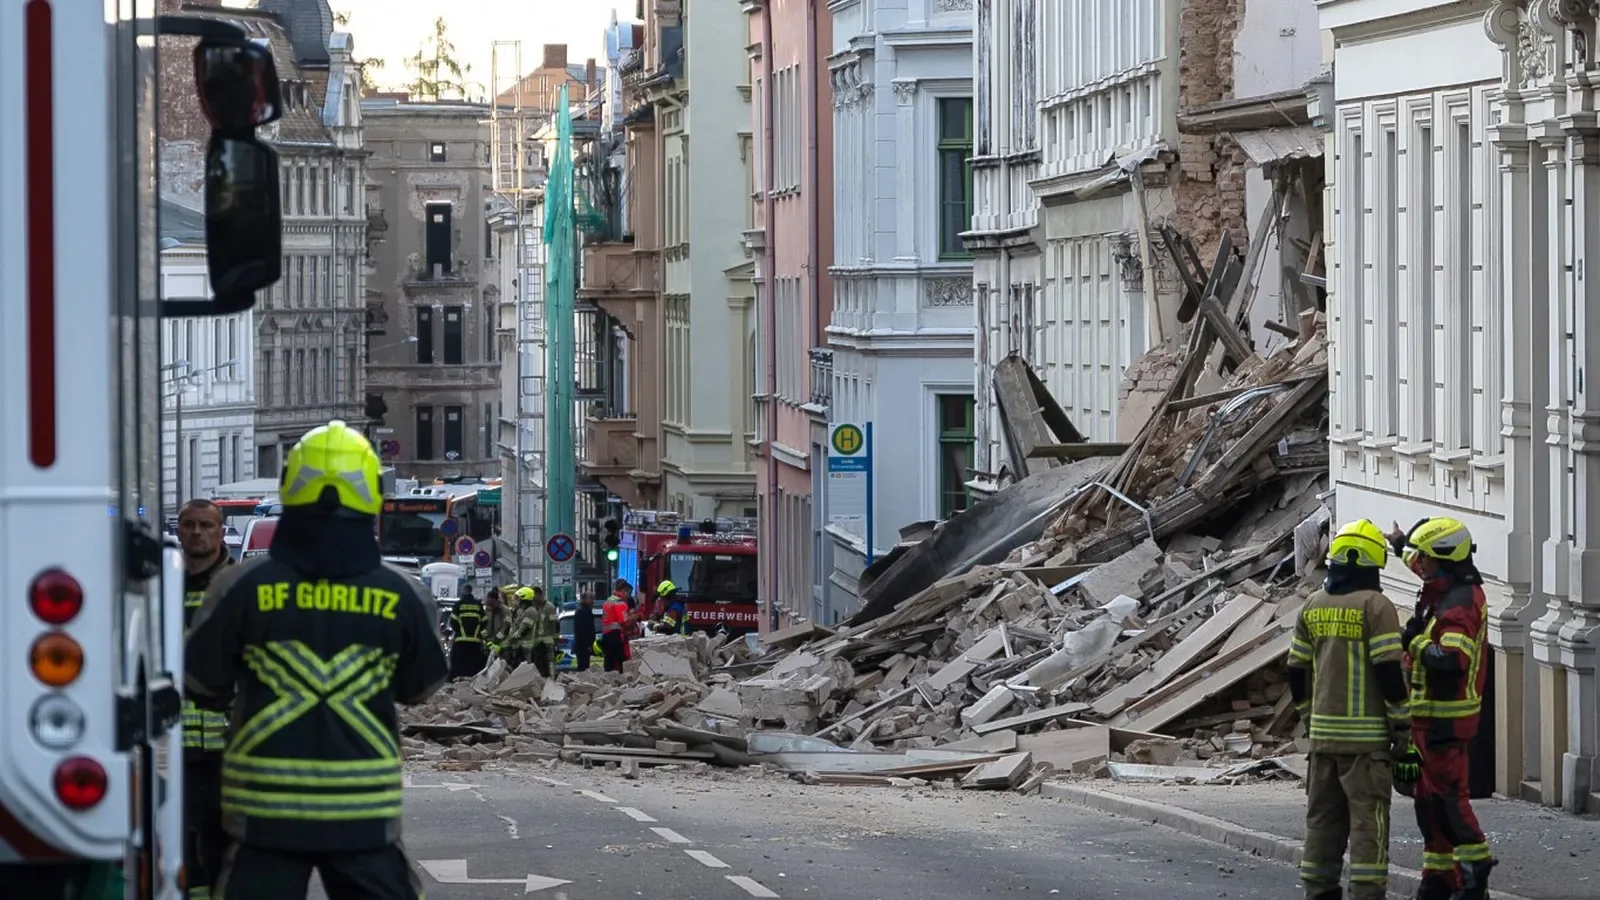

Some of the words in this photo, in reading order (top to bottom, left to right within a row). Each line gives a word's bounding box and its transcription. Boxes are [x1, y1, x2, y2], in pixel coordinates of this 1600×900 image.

[841, 430, 854, 449] H
[257, 583, 290, 612] BF
[296, 579, 400, 620] GÖRLITZ
[687, 611, 759, 621] FEUERWEHR
